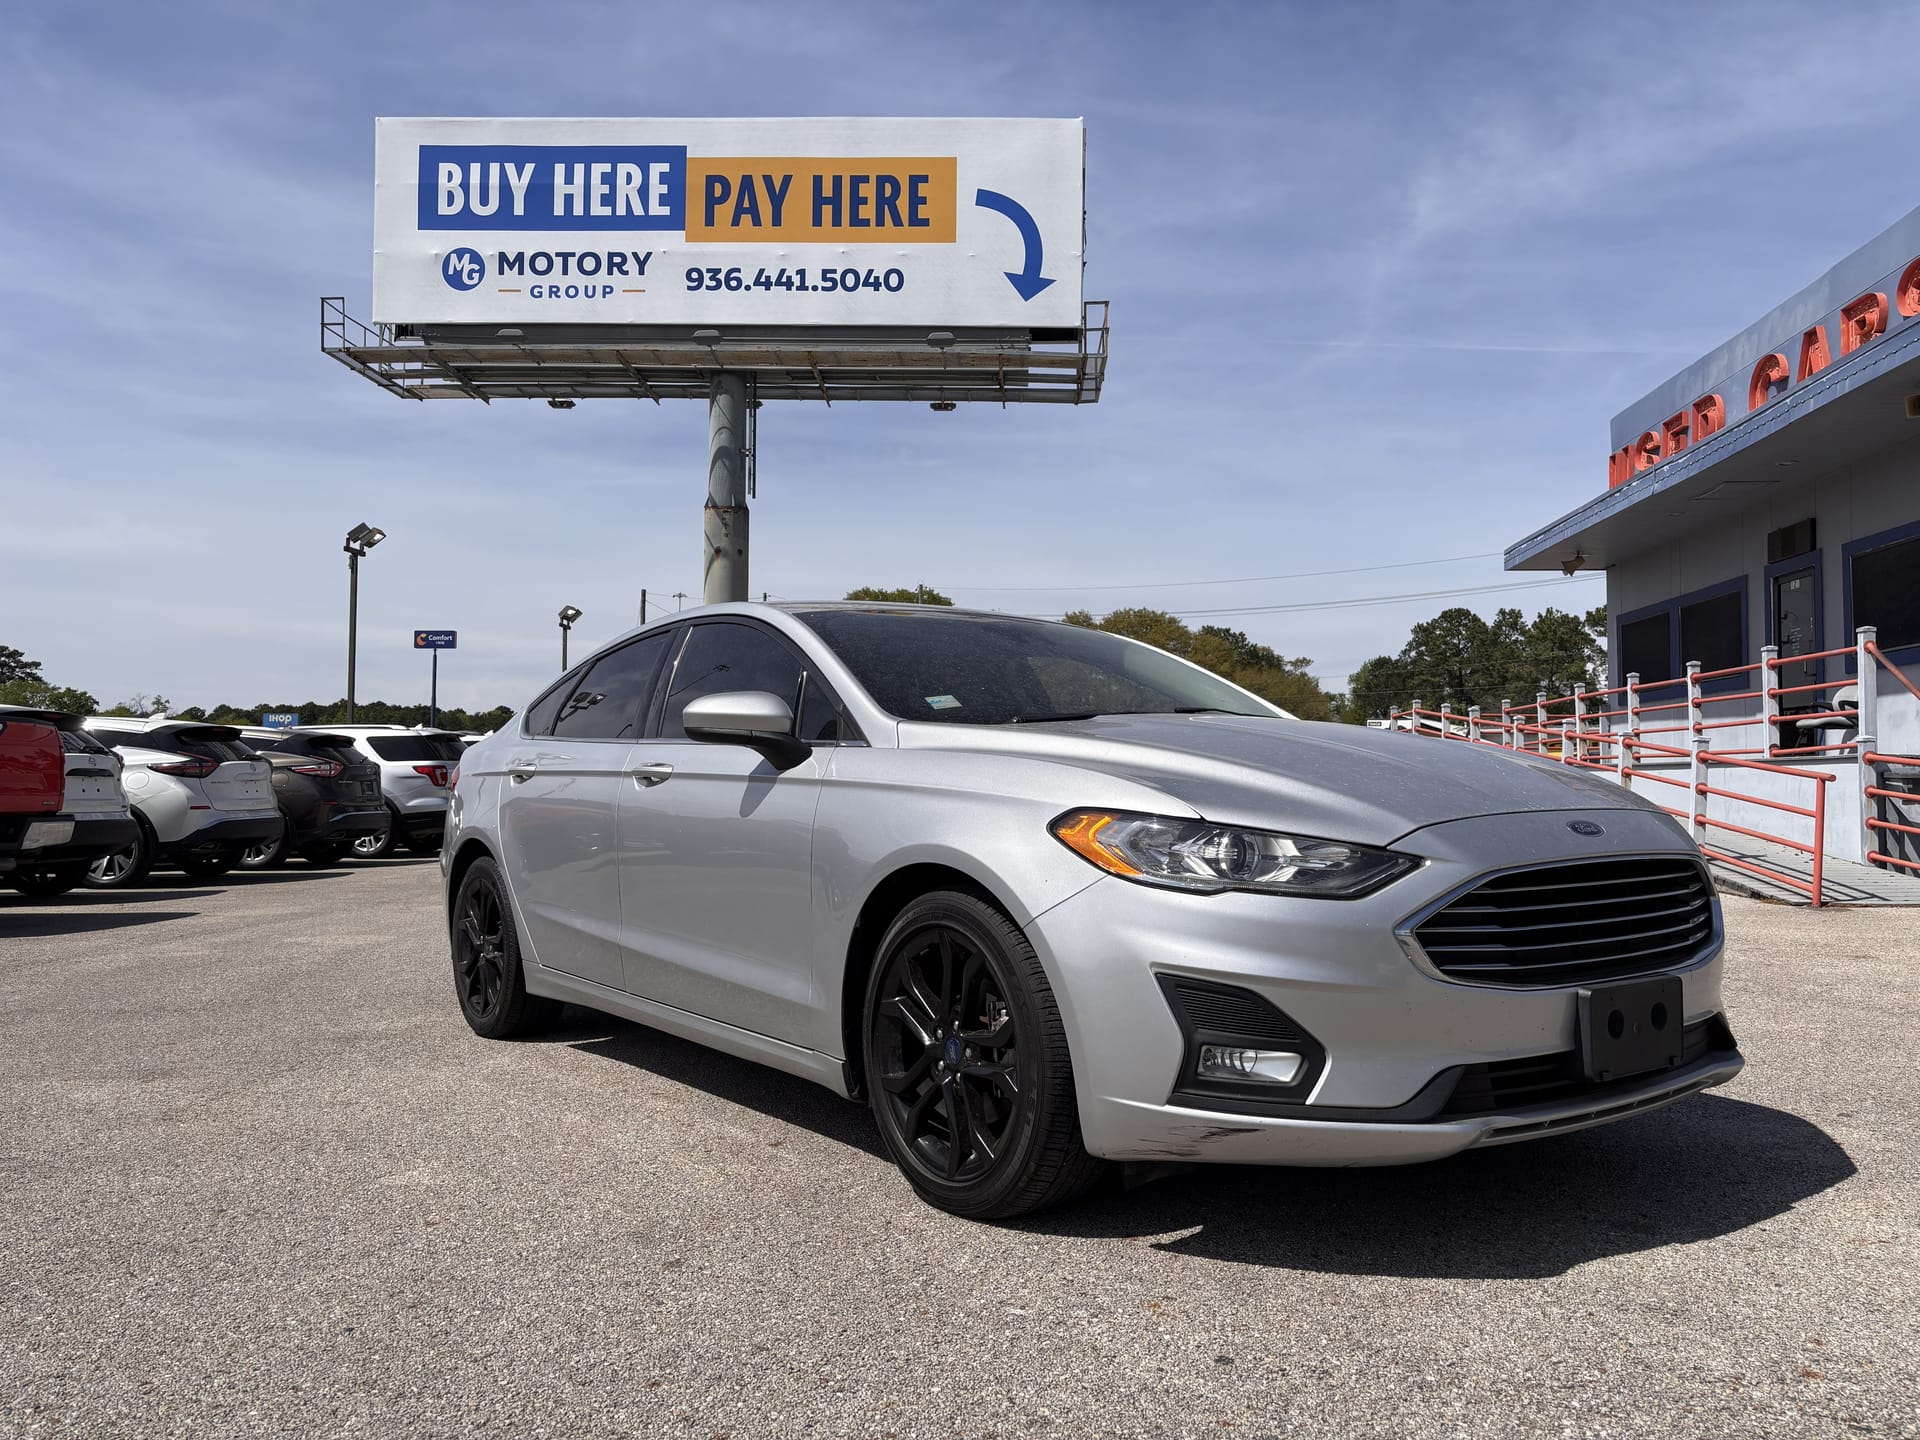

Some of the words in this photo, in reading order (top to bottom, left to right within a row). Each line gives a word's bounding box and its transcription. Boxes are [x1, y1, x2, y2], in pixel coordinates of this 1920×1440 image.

[437, 162, 537, 217] BUY
[552, 162, 671, 217] HERE
[704, 174, 794, 227] PAY
[811, 174, 930, 227] HERE
[448, 253, 481, 285] MG
[498, 251, 653, 276] MOTORY
[529, 284, 615, 299] GROUP
[685, 267, 905, 292] 936.441.5040
[269, 714, 292, 725] IHOP
